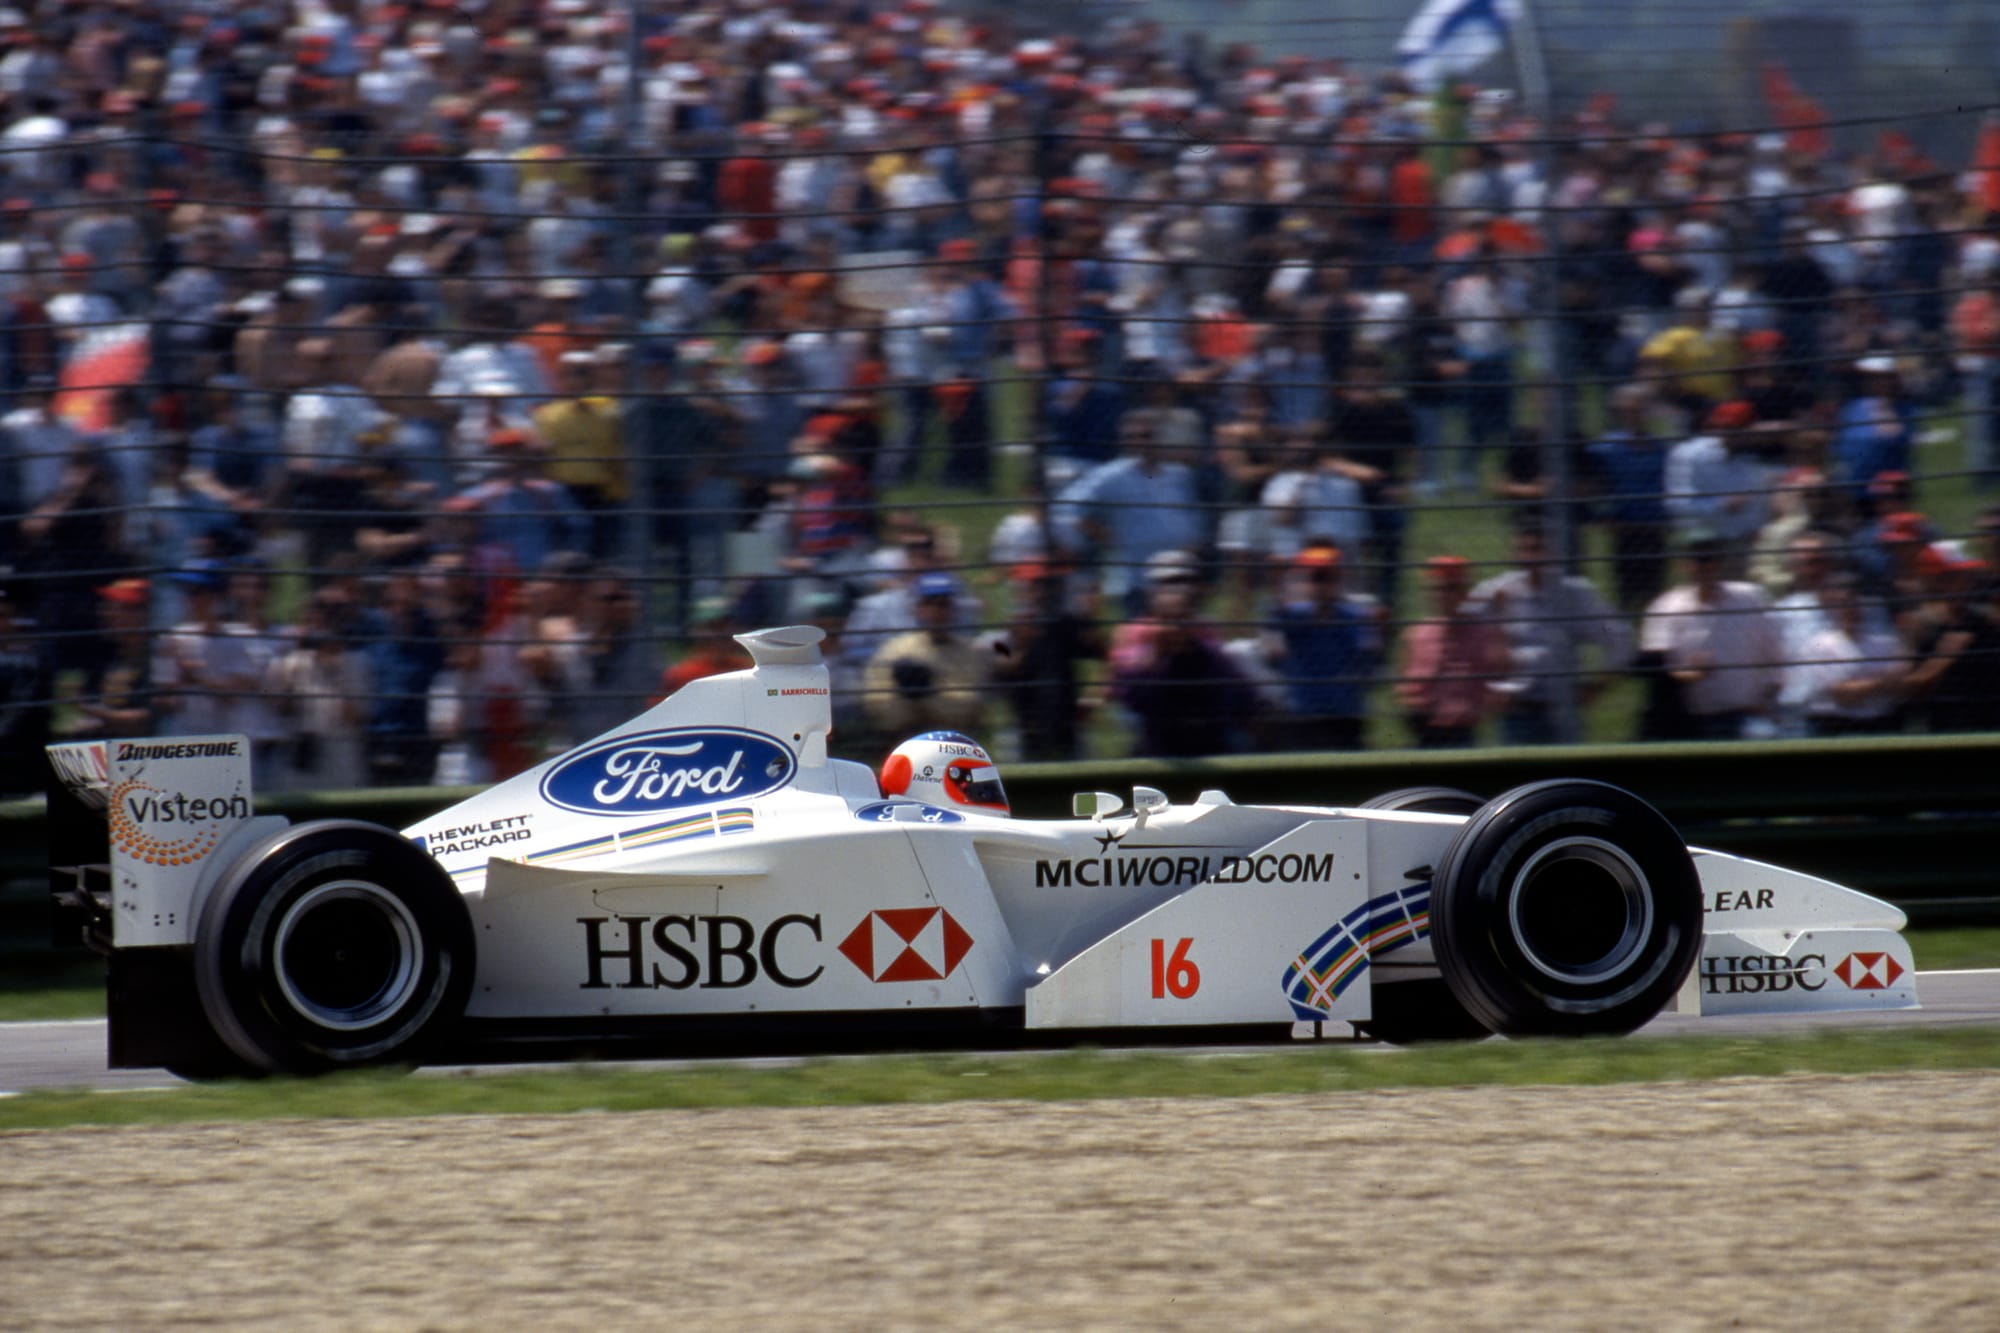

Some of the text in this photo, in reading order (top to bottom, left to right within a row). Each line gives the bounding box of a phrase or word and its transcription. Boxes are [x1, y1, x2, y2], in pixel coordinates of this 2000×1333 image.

[116, 742, 238, 762] BRIDGESTONE
[938, 744, 971, 756] HSBC
[593, 741, 743, 804] Ford
[128, 792, 248, 823] Visteon
[428, 815, 528, 844] HEWLETT
[431, 829, 532, 857] PACKARD
[576, 914, 825, 990] HSBC
[1151, 937, 1200, 999] 16
[1703, 954, 1827, 994] HSBC
